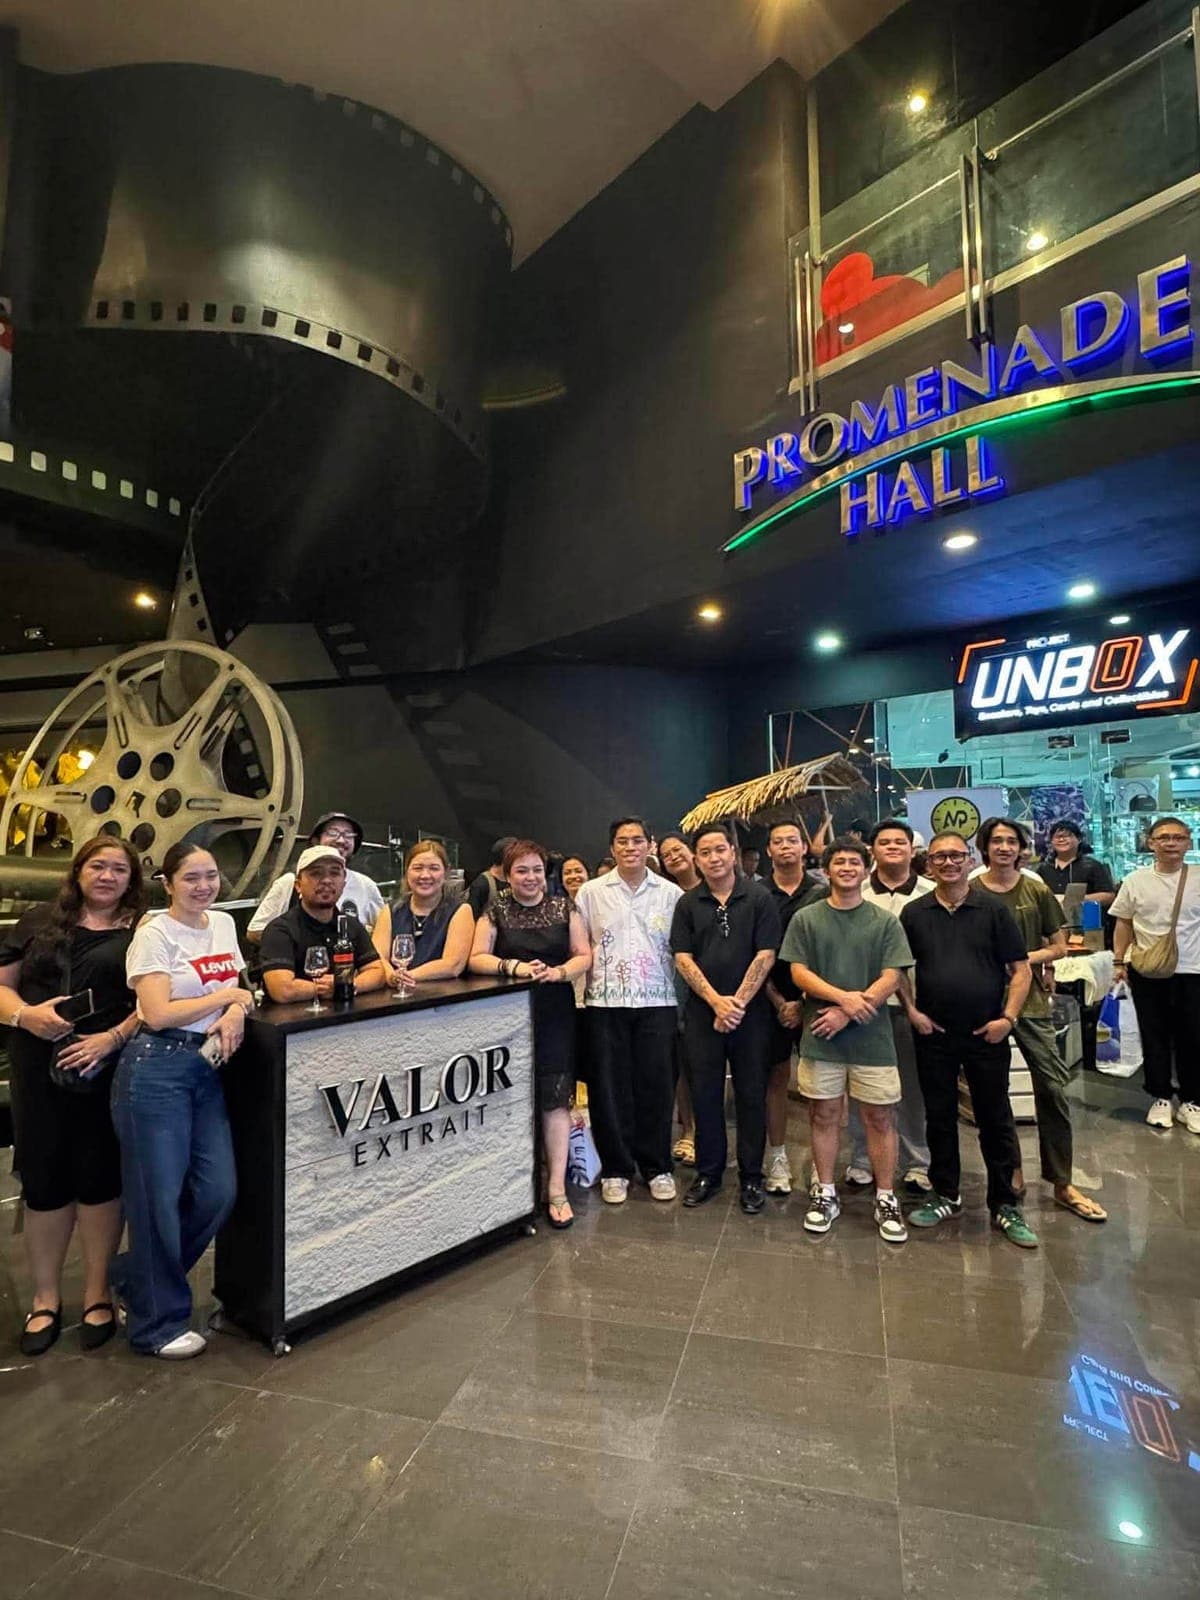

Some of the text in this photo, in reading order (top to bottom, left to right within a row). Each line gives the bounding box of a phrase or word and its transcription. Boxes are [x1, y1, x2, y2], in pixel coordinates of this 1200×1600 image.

[733, 254, 1193, 511] PROMENADE
[839, 434, 1004, 536] HALL
[971, 629, 1190, 708] UNBOX
[1081, 697, 1104, 708] and
[319, 1045, 513, 1137] VALOR
[354, 1103, 488, 1167] EXTRAIT
